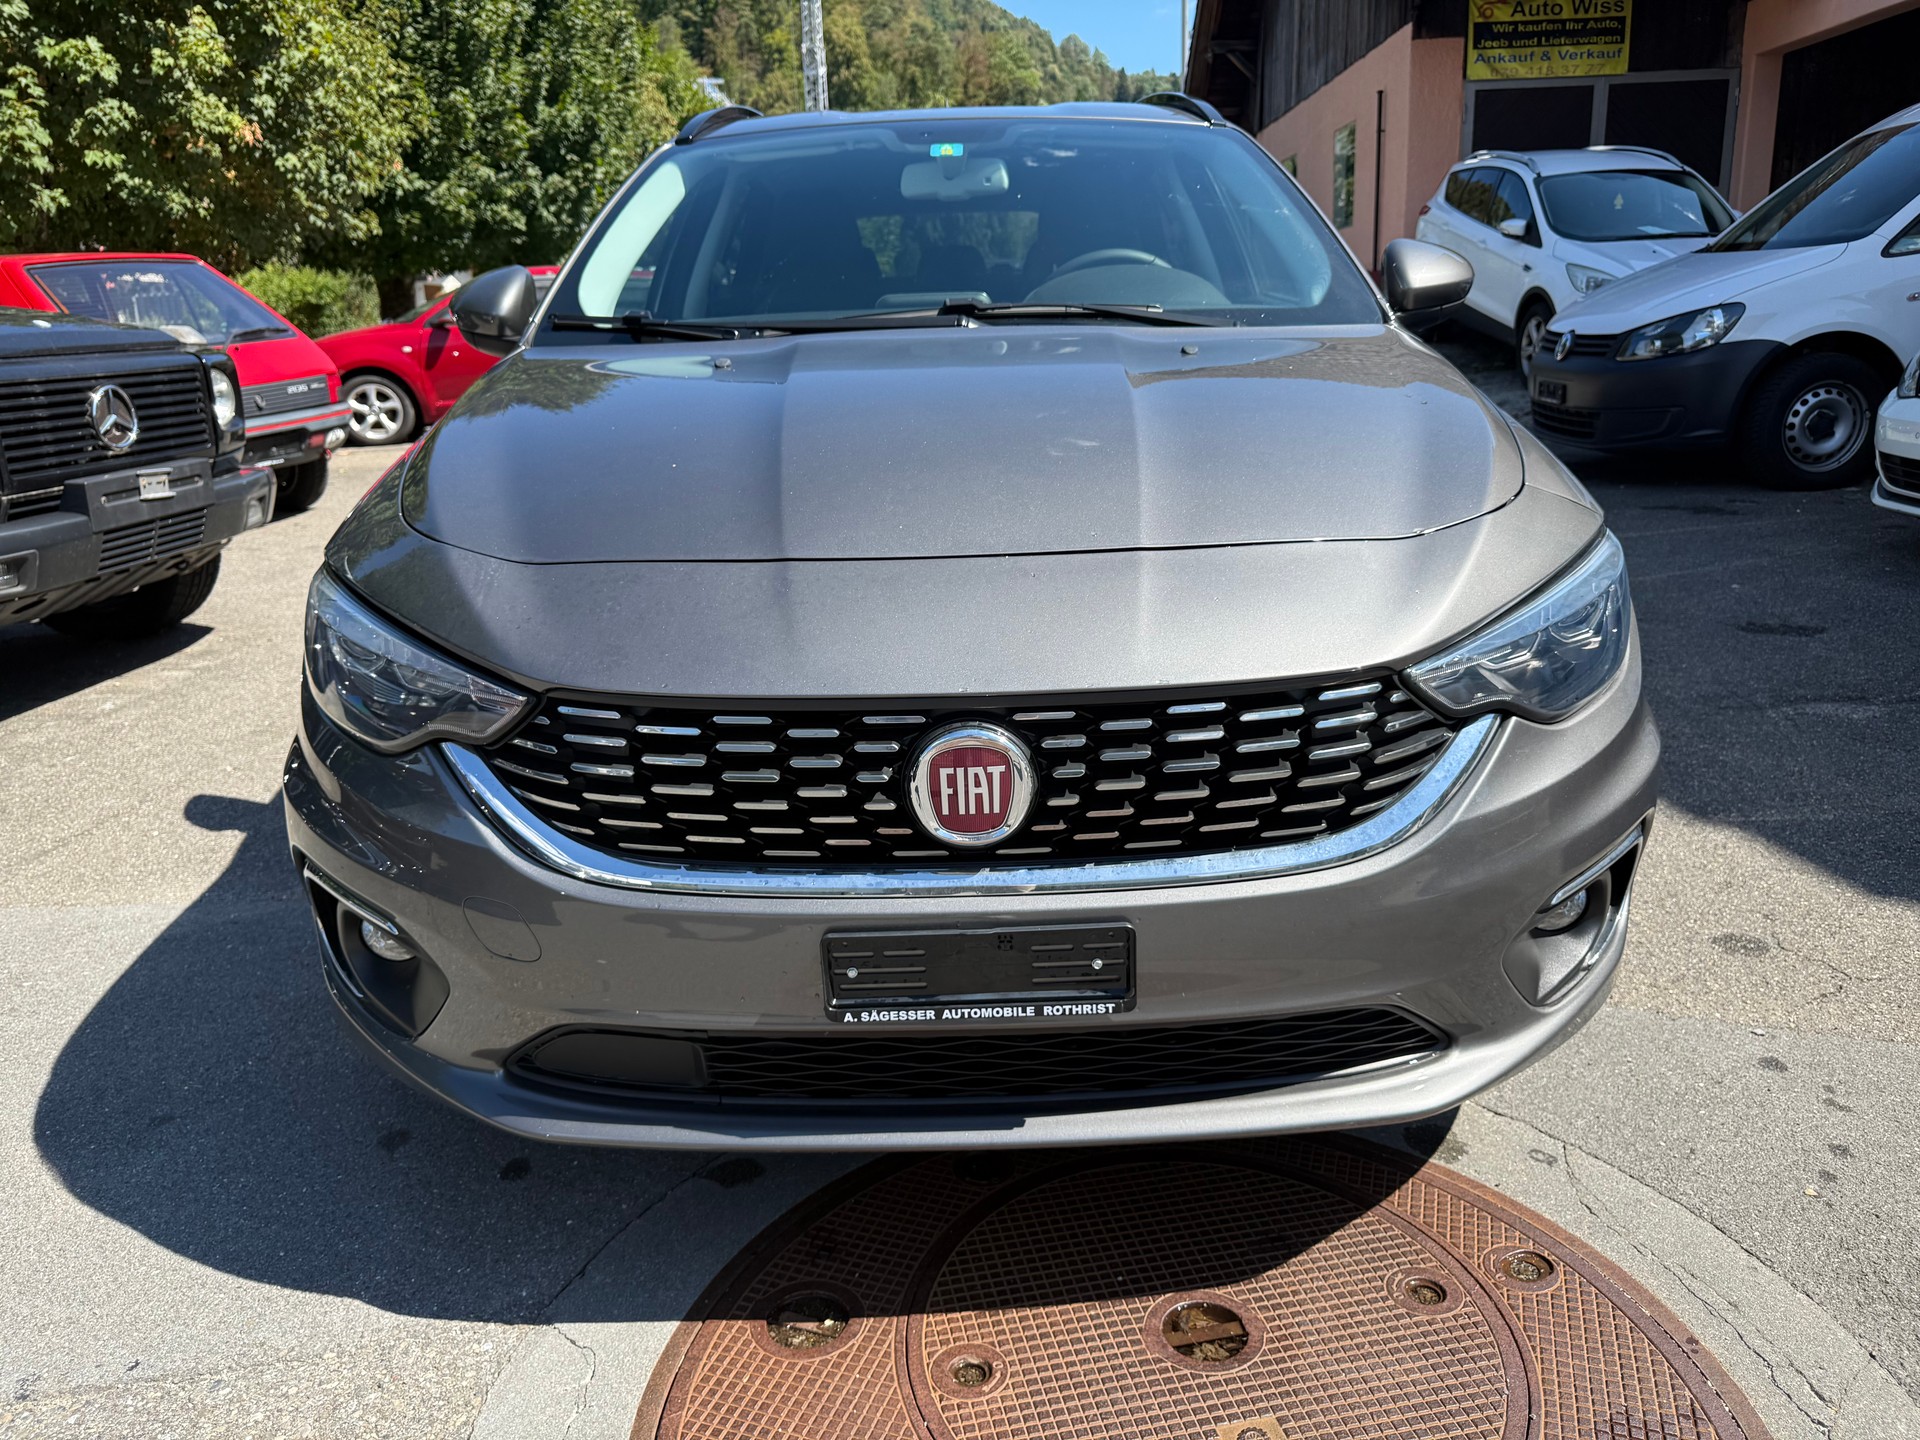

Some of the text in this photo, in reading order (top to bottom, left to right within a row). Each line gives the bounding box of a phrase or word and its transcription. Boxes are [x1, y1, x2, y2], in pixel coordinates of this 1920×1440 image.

[1510, 0, 1625, 17] Auto Wiss
[1492, 19, 1622, 33] Wir kaufen Ihr Auto,
[1512, 36, 1538, 47] und
[1541, 35, 1621, 47] Lieferwagen
[1474, 48, 1624, 64] Ankauf & Verkauf
[1561, 64, 1579, 75] 37
[939, 765, 1006, 815] FIAT
[844, 1004, 1116, 1022] A. SÄGESSER AUTOMOBILE ROTHRIST
